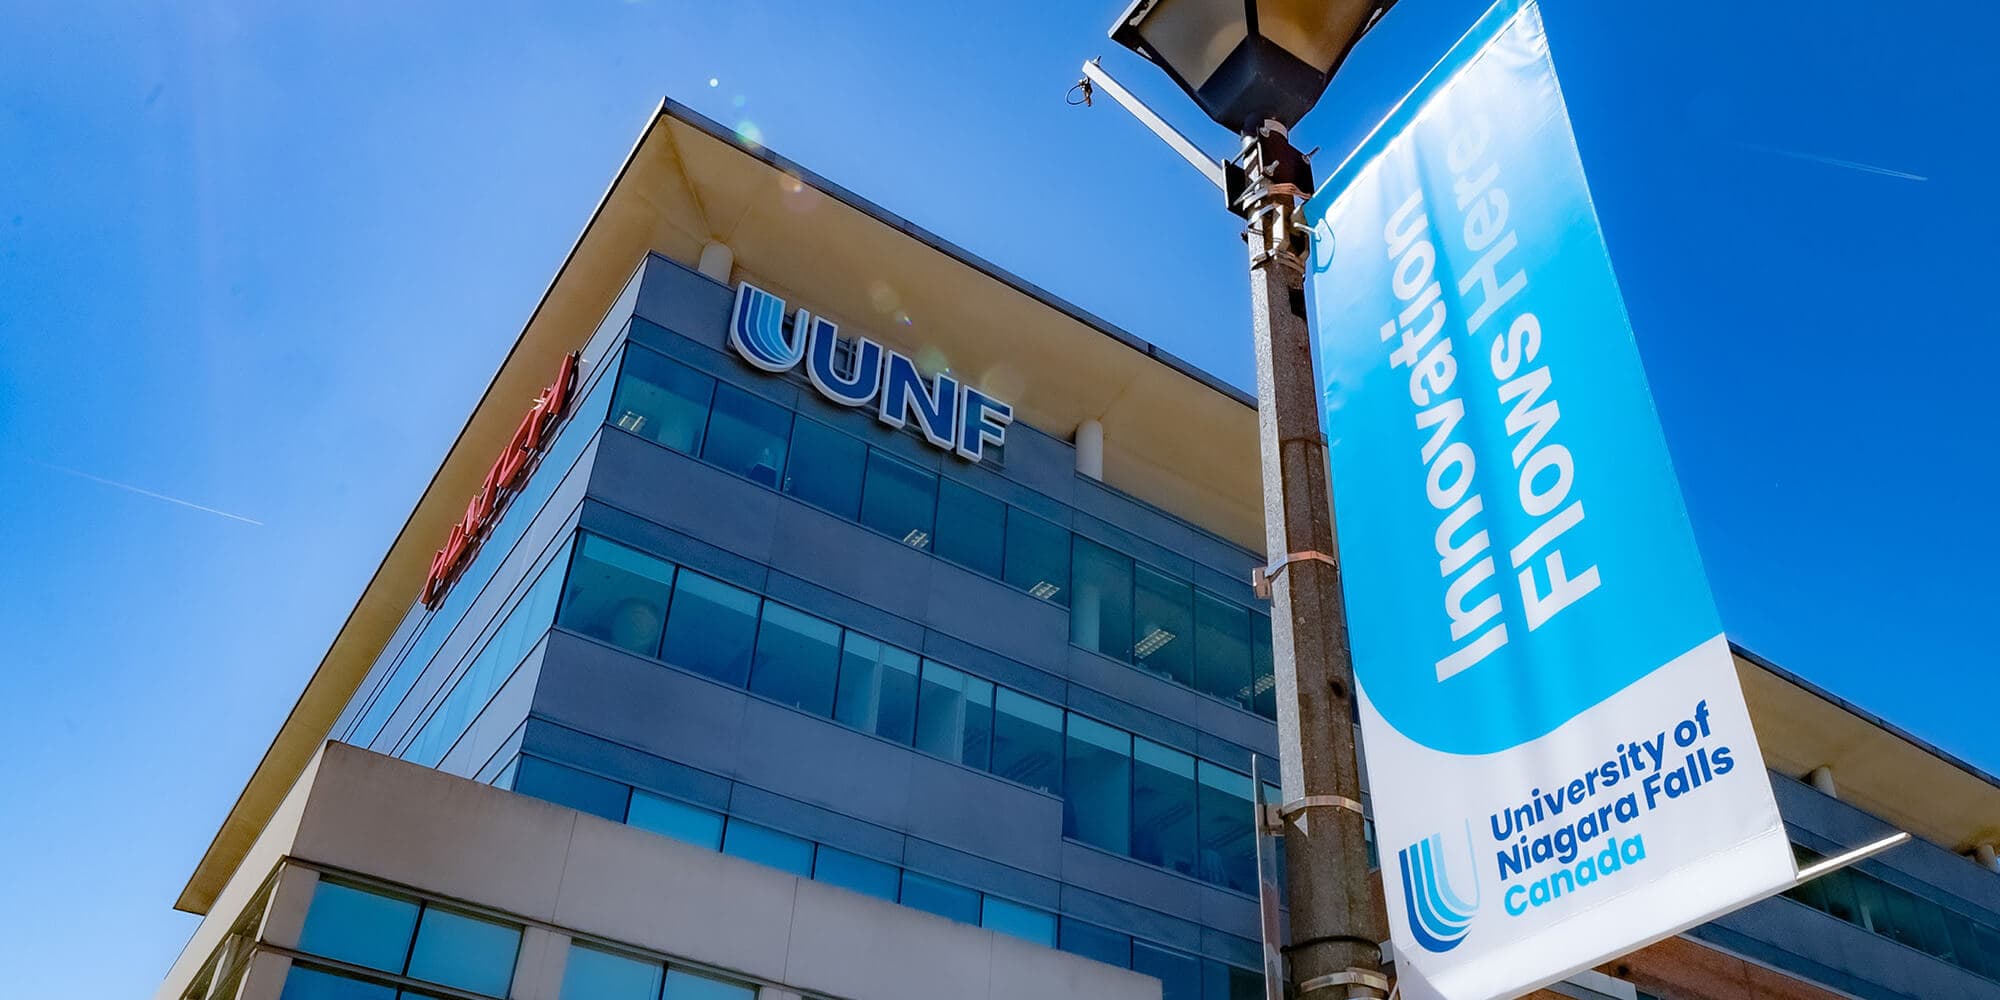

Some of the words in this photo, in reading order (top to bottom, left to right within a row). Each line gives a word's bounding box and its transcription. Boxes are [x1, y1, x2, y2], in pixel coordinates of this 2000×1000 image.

[1447, 112, 1528, 336] Here
[1380, 189, 1509, 683] Innovation
[1490, 312, 1602, 632] Flows
[1490, 731, 1666, 842] University
[1673, 699, 1711, 748] of
[1496, 792, 1640, 881] Niagara
[1642, 746, 1735, 811] Falls
[1503, 833, 1647, 917] Canada
